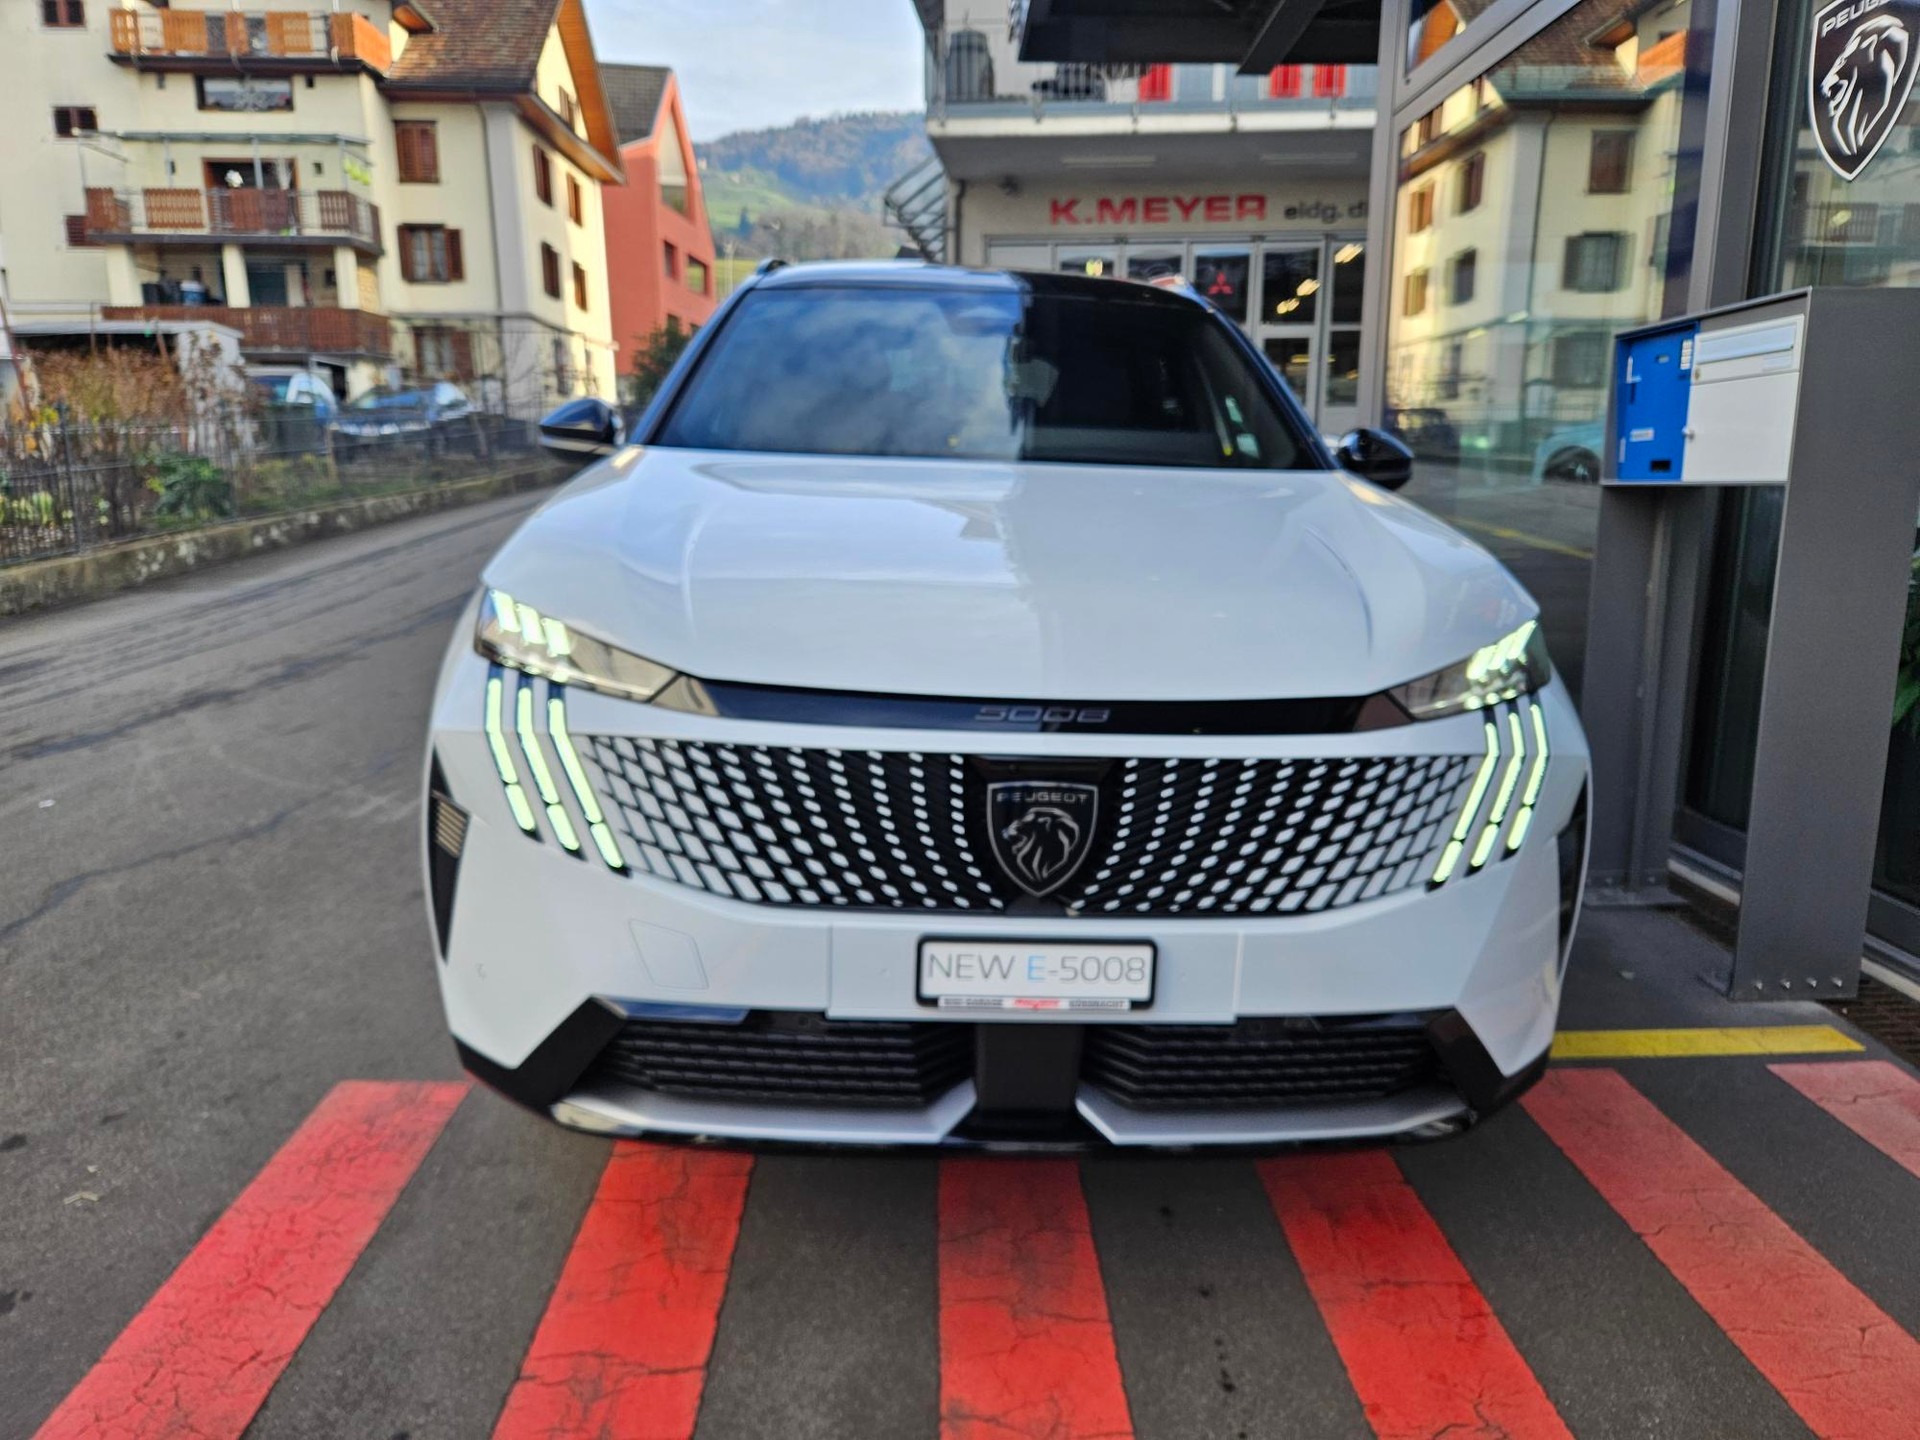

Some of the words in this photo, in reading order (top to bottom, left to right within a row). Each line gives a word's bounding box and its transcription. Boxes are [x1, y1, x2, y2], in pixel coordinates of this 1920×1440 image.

[1050, 194, 1267, 225] K.MEYER
[974, 705, 1111, 723] 5008
[996, 792, 1089, 803] PEUGEOT
[928, 954, 1015, 980] NEW
[1027, 955, 1146, 982] E-5008
